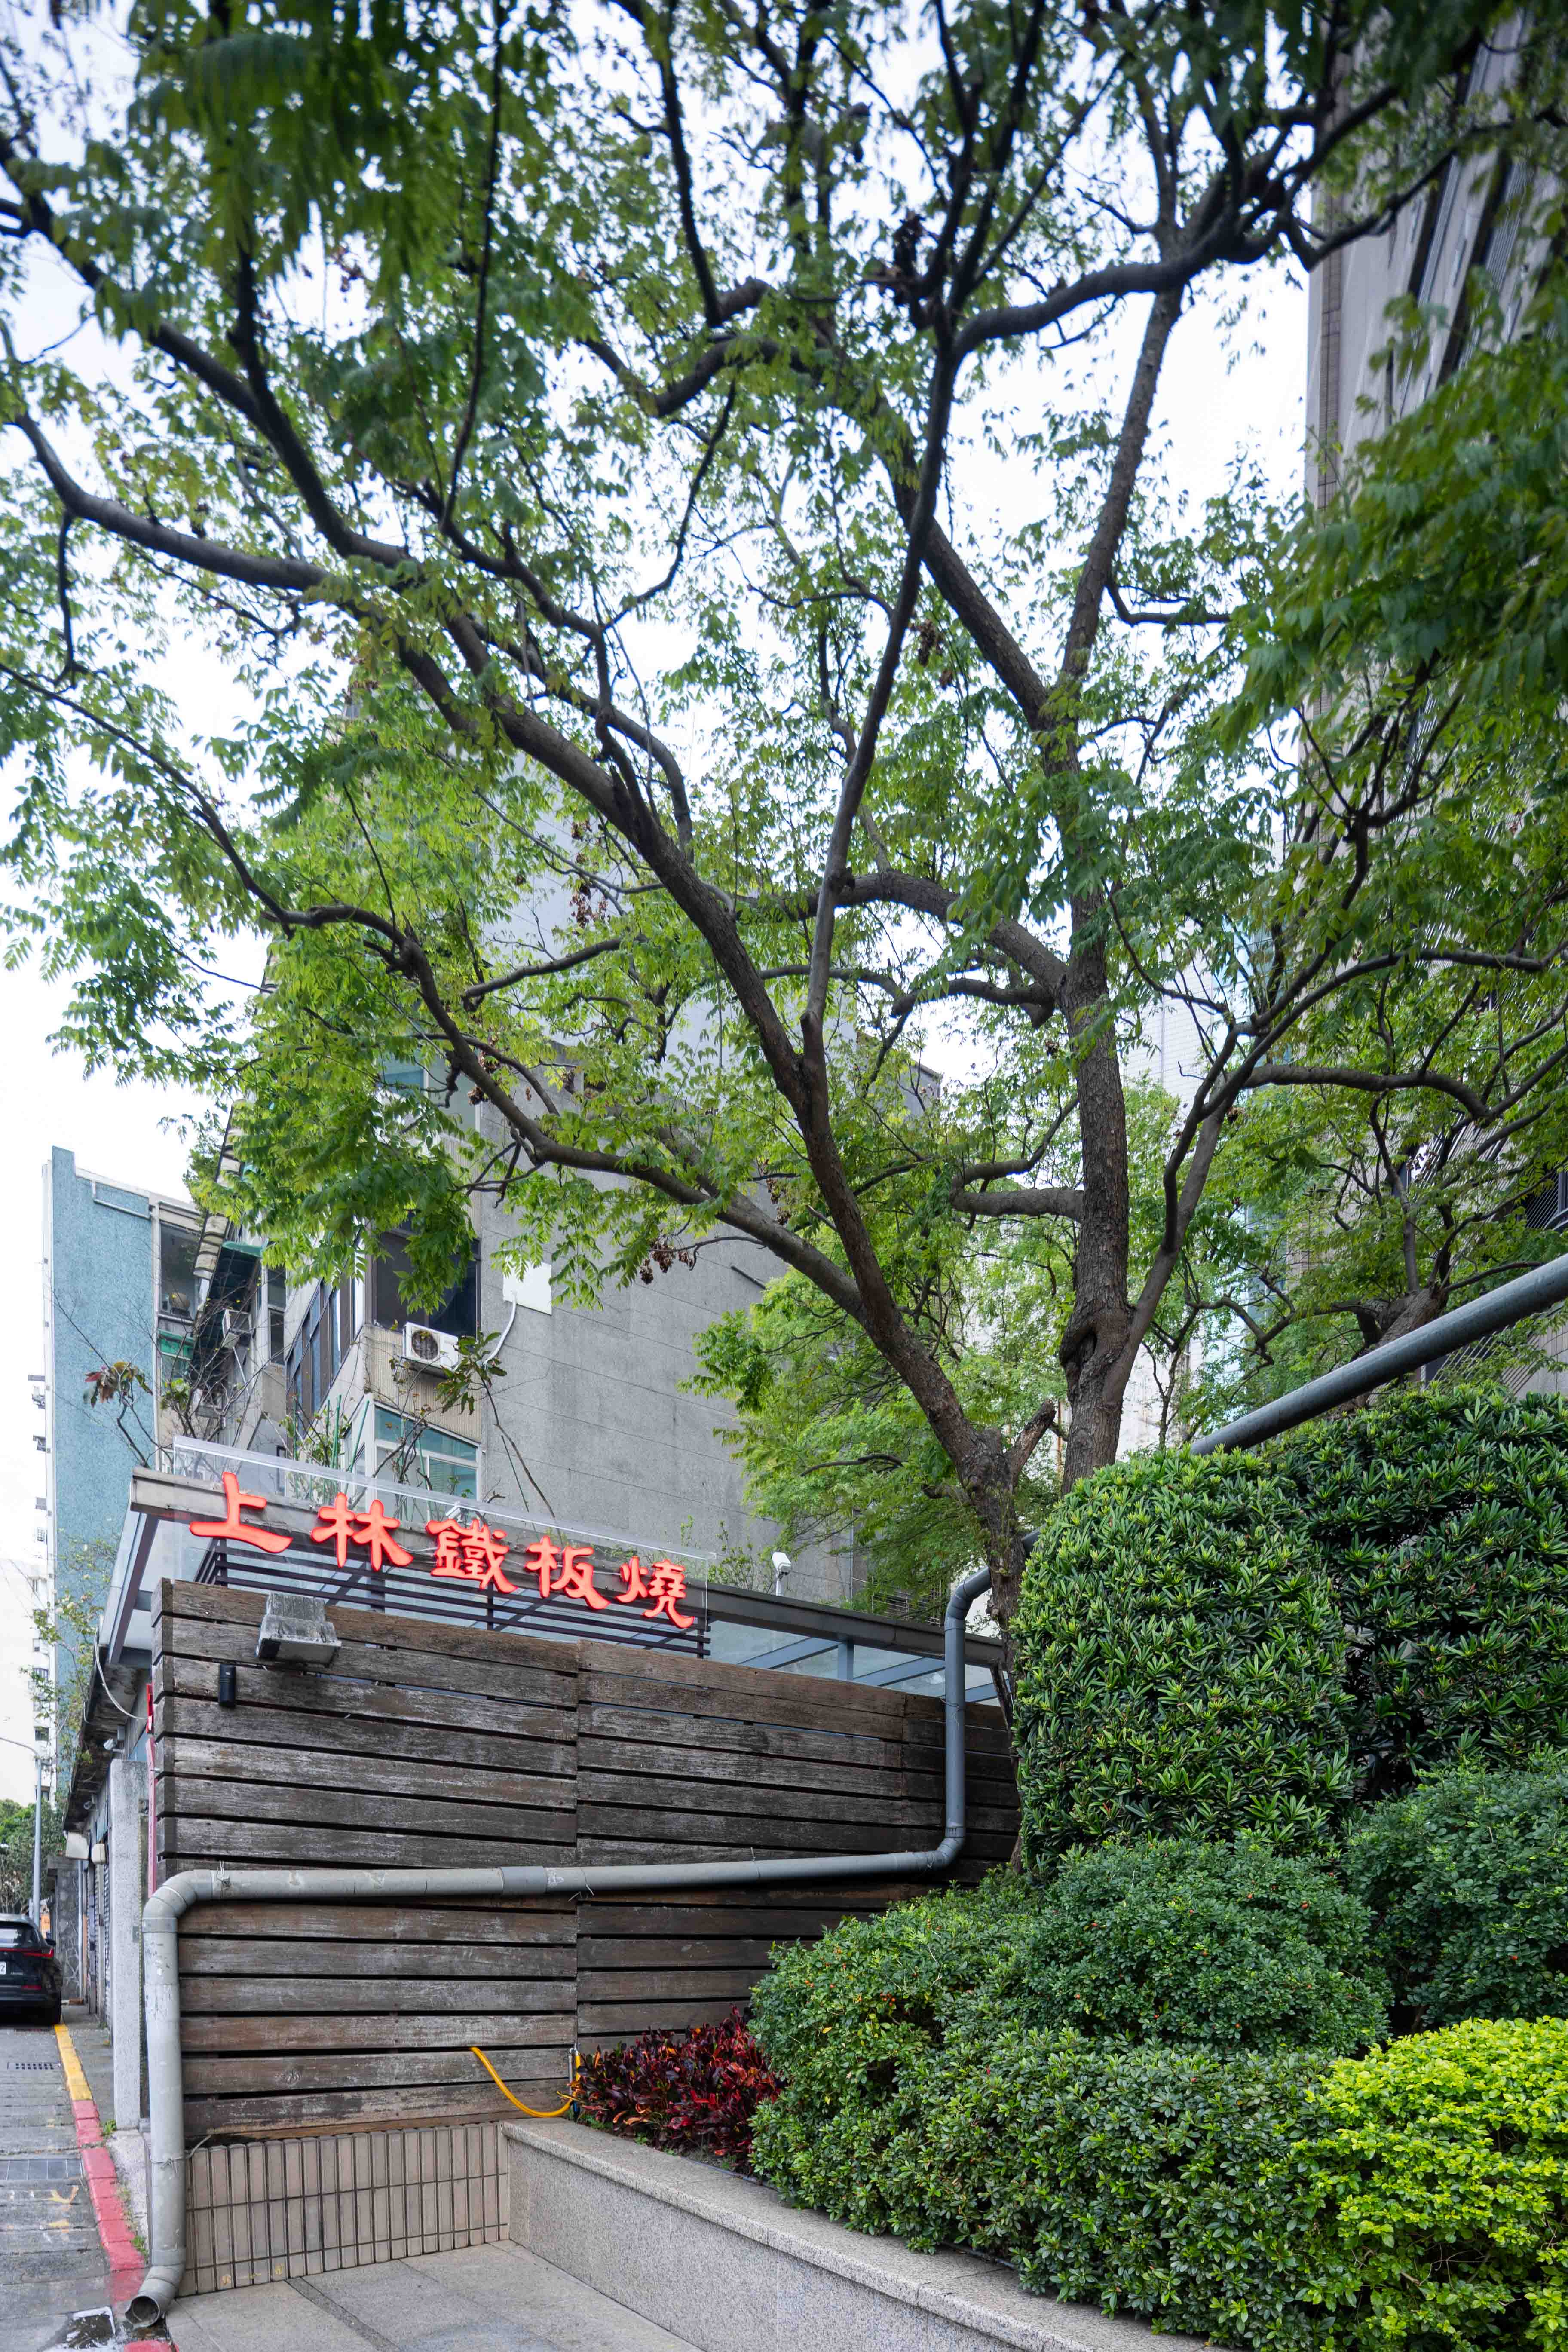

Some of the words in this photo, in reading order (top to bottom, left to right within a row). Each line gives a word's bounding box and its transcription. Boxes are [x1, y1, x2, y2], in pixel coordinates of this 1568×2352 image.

[189, 1471, 695, 1628] 上林鐵板燒
